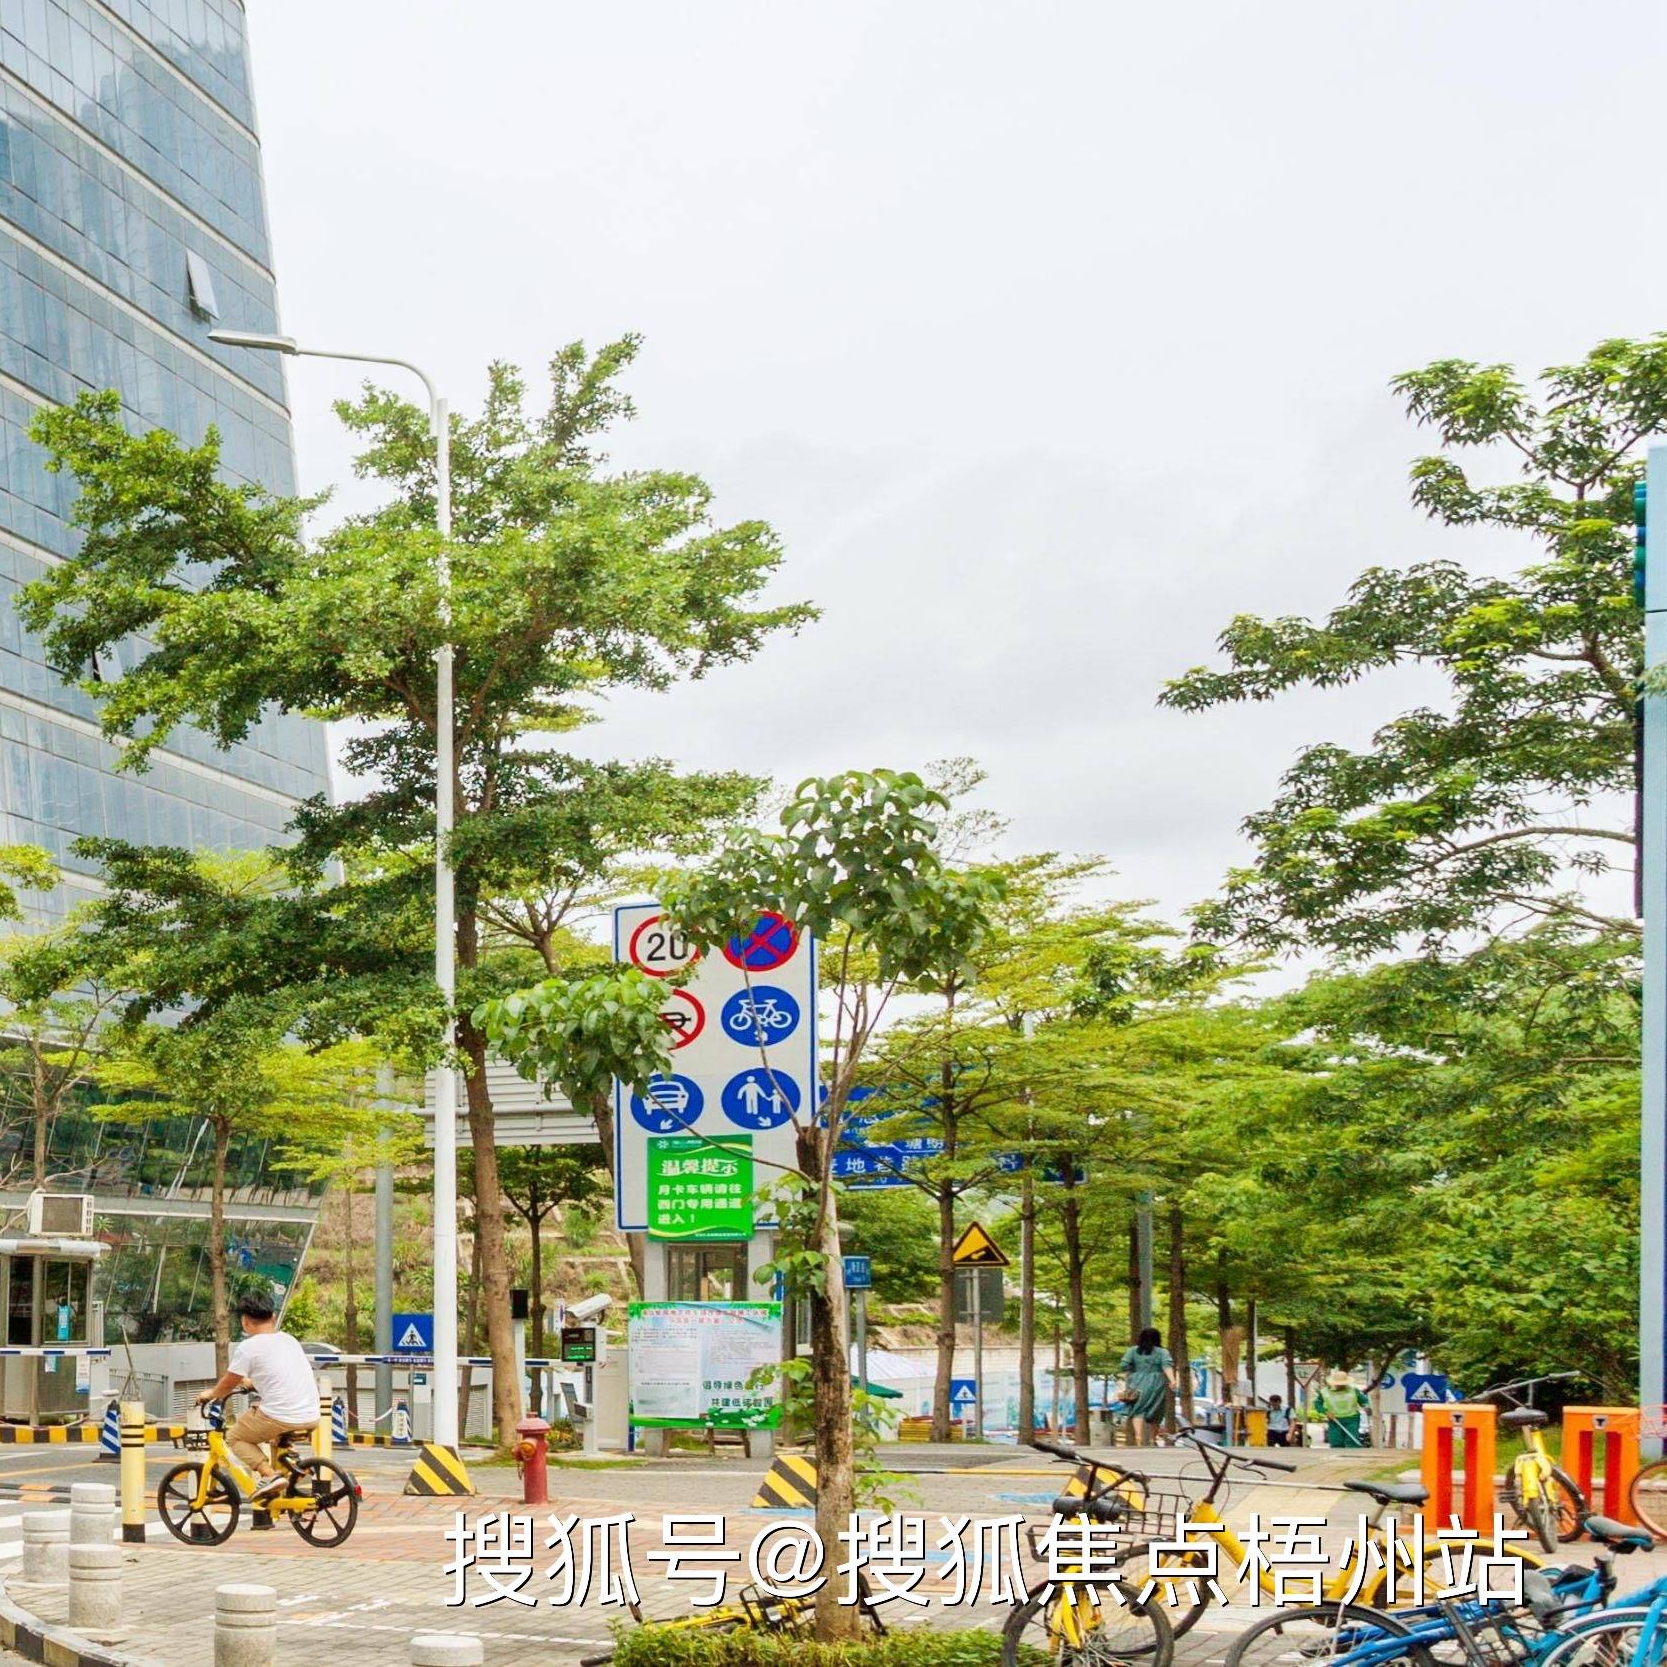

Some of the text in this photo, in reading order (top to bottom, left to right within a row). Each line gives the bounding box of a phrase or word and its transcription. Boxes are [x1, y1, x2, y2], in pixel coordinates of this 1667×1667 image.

[646, 931, 688, 962] 20
[659, 1158, 739, 1176] 温馨提示
[702, 1380, 764, 1391] 倡导绿色行
